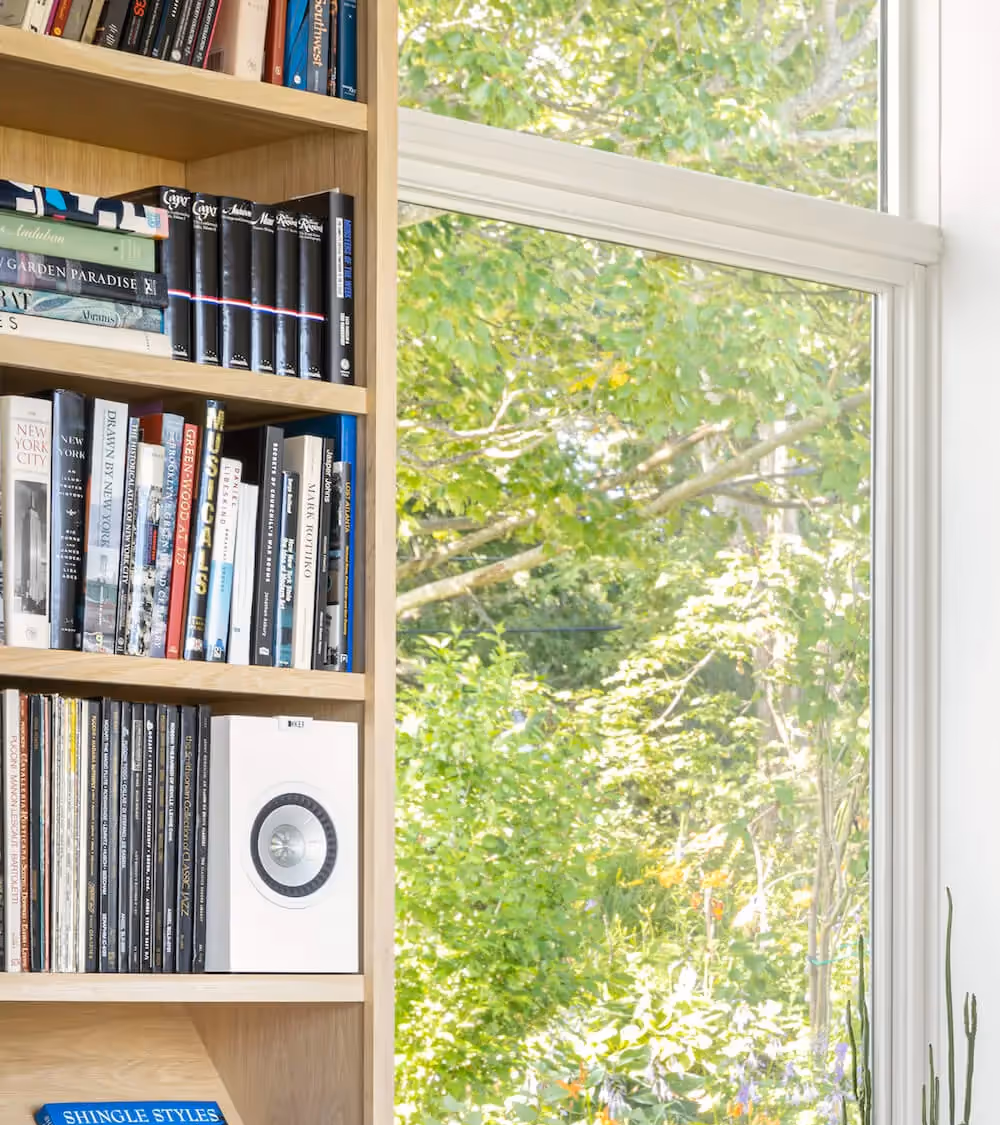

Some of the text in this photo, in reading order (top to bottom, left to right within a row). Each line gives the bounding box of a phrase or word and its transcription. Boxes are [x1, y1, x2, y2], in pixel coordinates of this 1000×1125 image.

[7, 256, 67, 278] GARDEN
[71, 267, 138, 291] PARADISE
[15, 438, 49, 454] YORK
[17, 423, 48, 439] NEW
[60, 434, 85, 446] NEW
[17, 451, 47, 466] CITY
[57, 447, 86, 460] YORK
[128, 441, 137, 487] HISTORICAL
[271, 442, 279, 475] SECRETS
[100, 409, 117, 548] DRAWN BY NEW YORK
[231, 467, 241, 508] DANIEL
[324, 448, 334, 503] Jasper Johns
[126, 488, 134, 510] ATLAS
[176, 429, 195, 566] GREEN-WOOD AT 175
[267, 488, 276, 537] CHURCHILL'S
[124, 523, 132, 542] NEW
[303, 482, 316, 578] MARK ROTHKO
[123, 542, 131, 564] YORK
[121, 565, 130, 585] CITY
[185, 735, 193, 750] the
[10, 774, 19, 808] MANON
[184, 750, 193, 800] Smithsonian
[183, 800, 192, 842] Collection
[182, 850, 190, 889] CLASSIC
[181, 890, 189, 917] JAZZ
[63, 1108, 219, 1125] SHINGLE STYLES
